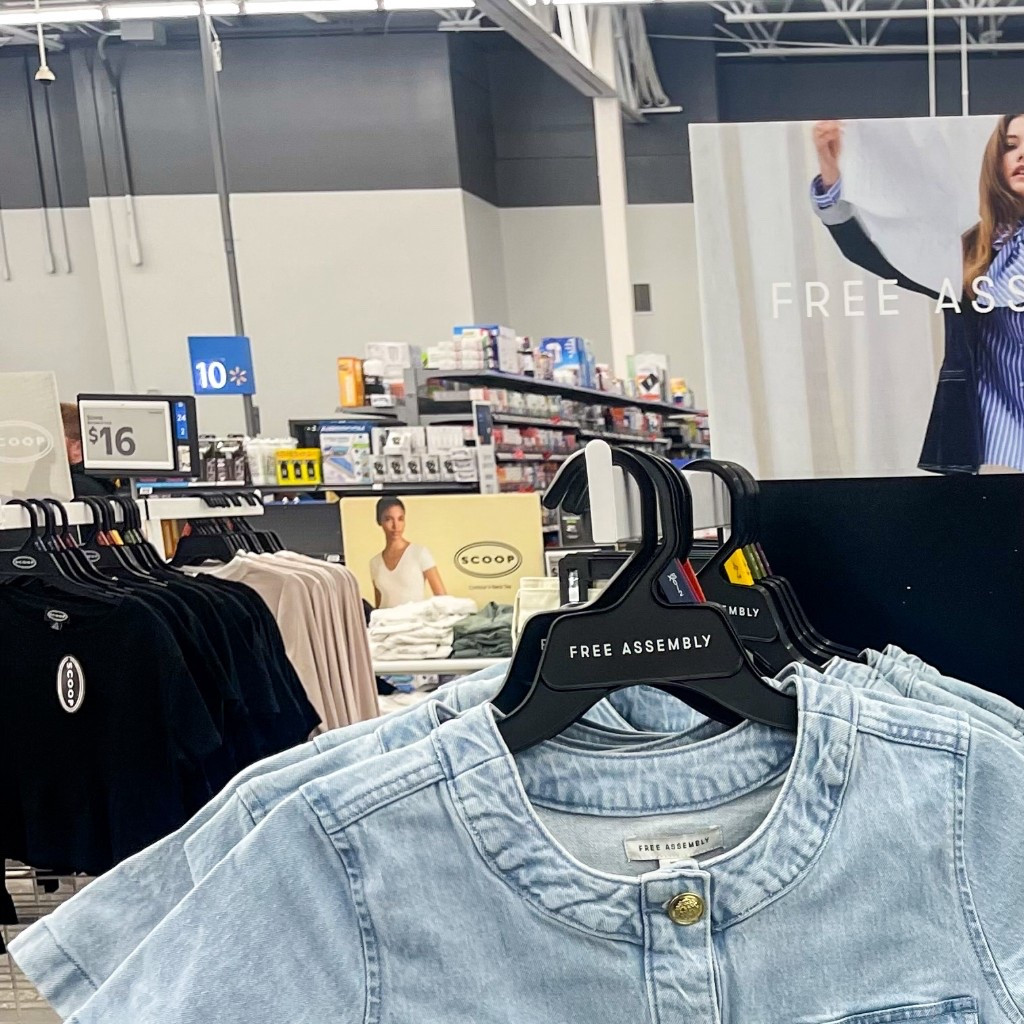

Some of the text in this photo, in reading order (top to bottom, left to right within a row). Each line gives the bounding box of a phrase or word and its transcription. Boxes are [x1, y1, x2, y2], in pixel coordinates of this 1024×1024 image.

[772, 279, 900, 318] FREE
[195, 360, 227, 390] 10
[88, 426, 137, 456] $16
[461, 555, 515, 565] SCOOP
[722, 604, 760, 617] MBLY
[569, 643, 613, 659] FREE
[622, 634, 712, 656] ASSEMBLY
[65, 661, 75, 707] SCOOP
[638, 836, 711, 852] FREE ASSEMBLY
